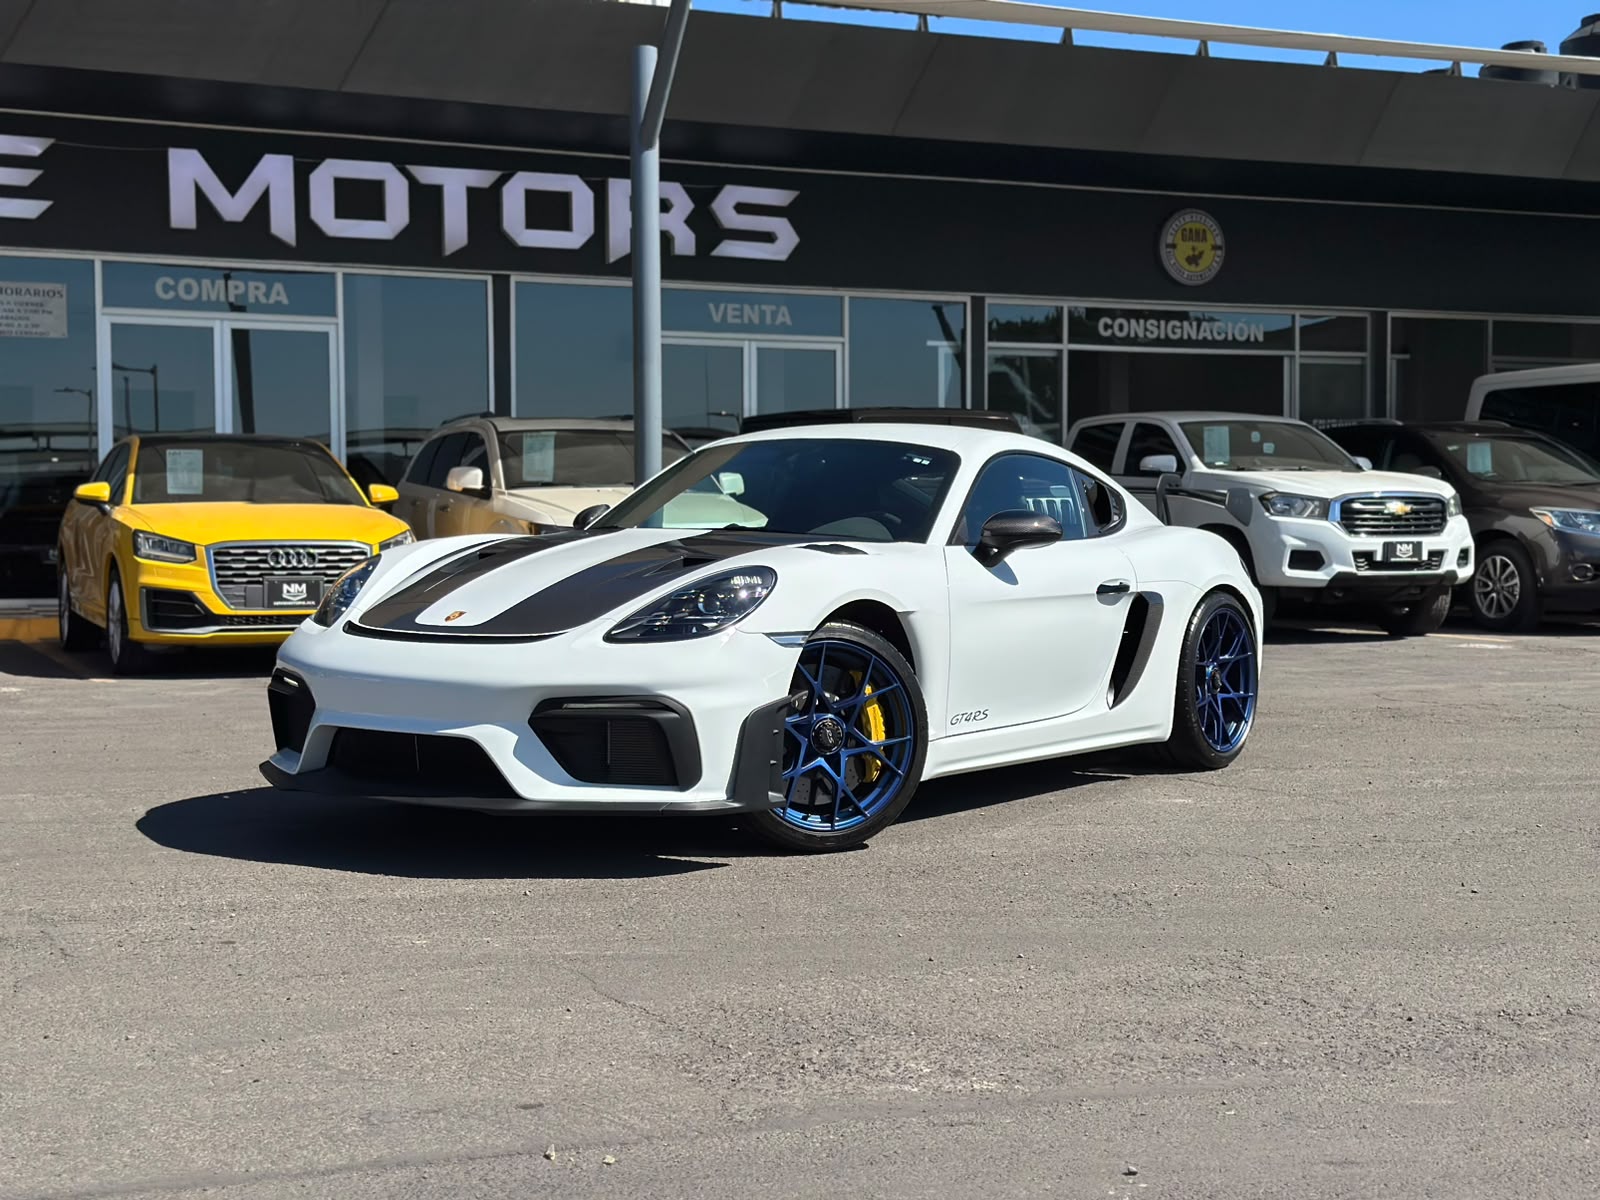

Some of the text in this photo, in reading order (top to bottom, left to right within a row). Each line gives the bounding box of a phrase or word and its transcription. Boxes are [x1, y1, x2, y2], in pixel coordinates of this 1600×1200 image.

[168, 147, 800, 263] MOTORS
[155, 276, 289, 305] COMPRA
[708, 302, 793, 326] VENTA
[1098, 316, 1265, 342] CONSIGNACIÓN
[282, 583, 307, 594] NM
